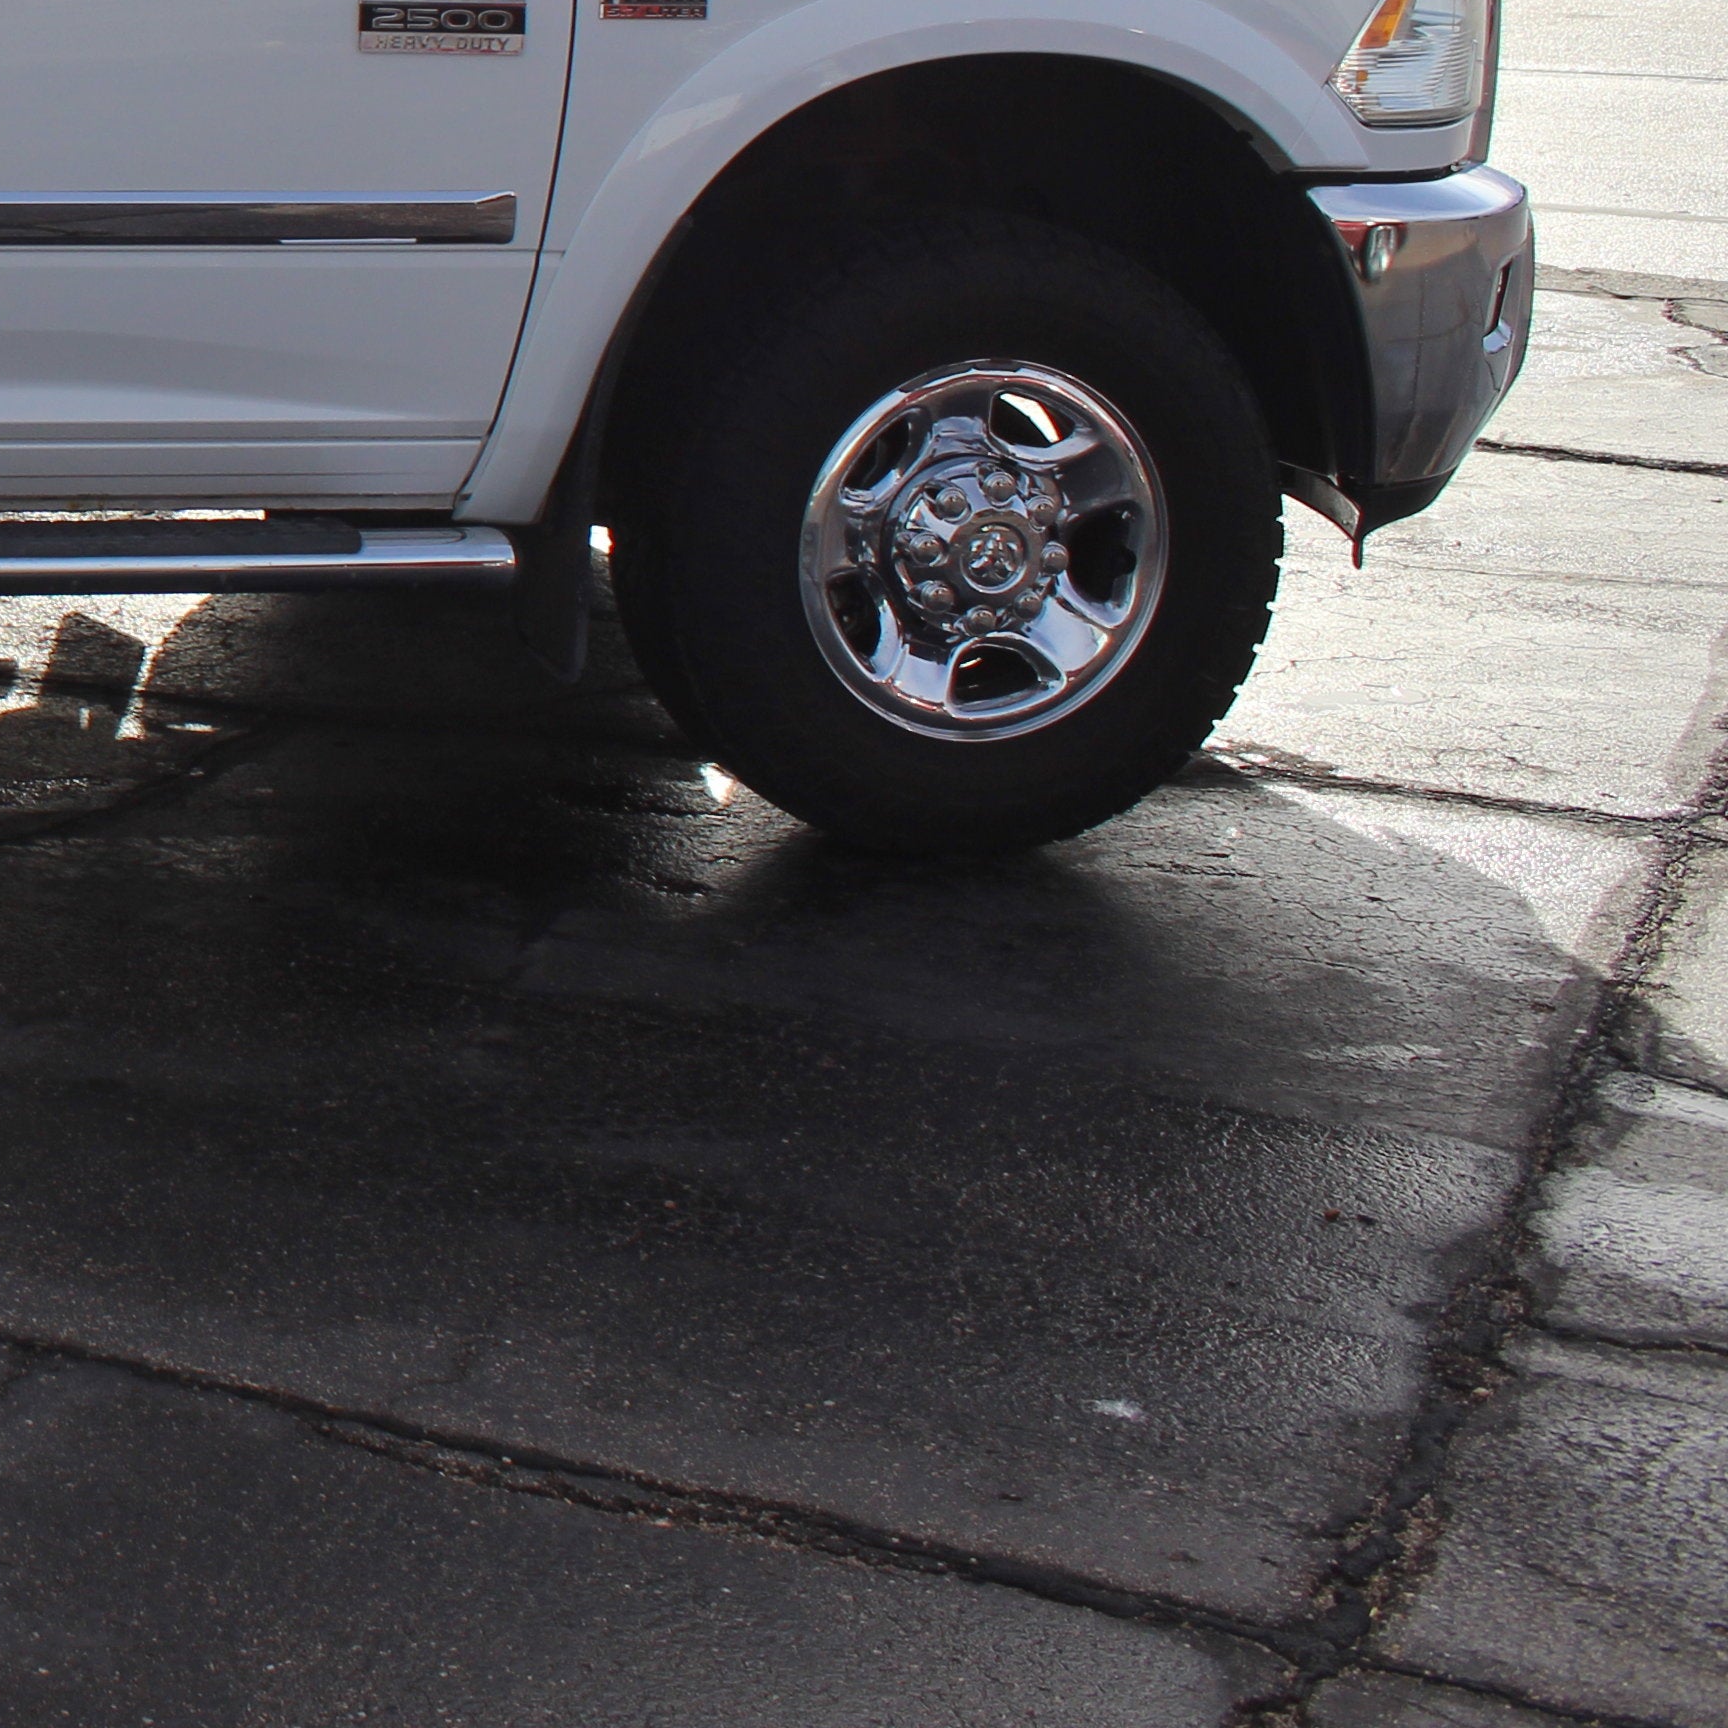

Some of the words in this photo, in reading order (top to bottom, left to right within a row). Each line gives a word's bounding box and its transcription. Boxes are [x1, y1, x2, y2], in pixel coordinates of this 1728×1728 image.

[372, 7, 514, 31] 2500
[375, 35, 446, 50] HEAVY
[456, 36, 510, 51] DUTY
